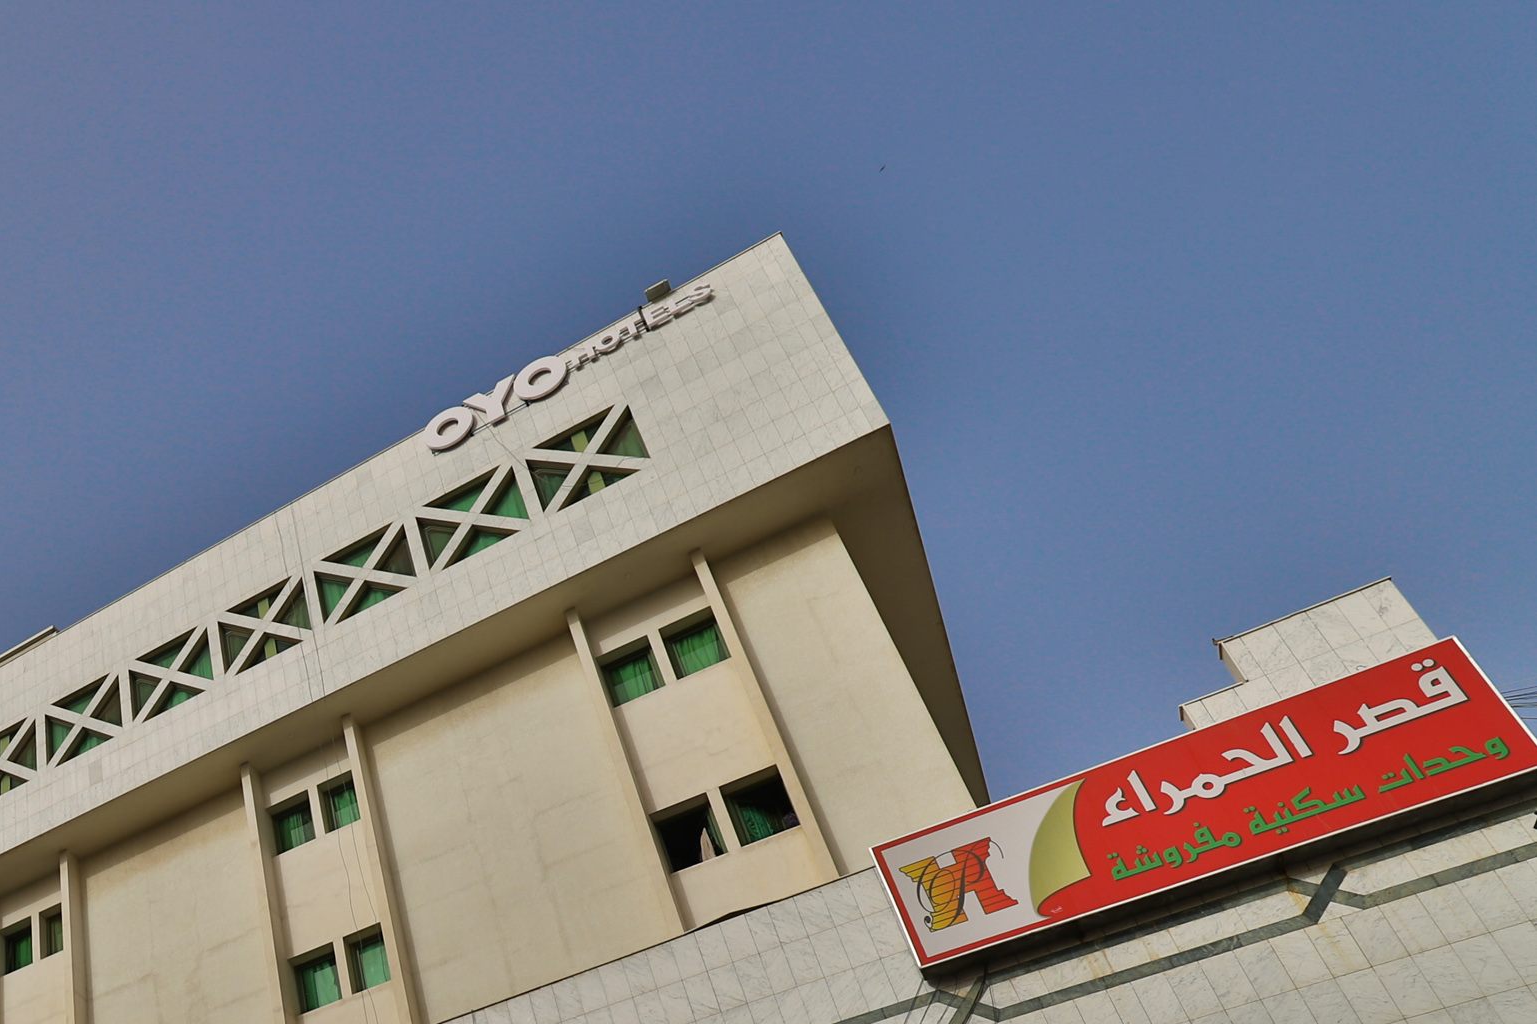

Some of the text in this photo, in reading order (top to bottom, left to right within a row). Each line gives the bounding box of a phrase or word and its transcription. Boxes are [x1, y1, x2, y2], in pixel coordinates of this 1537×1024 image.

[424, 283, 715, 450] OYO HOTELS
[1101, 657, 1469, 828] قصر الحمراء
[1109, 735, 1511, 882] وحدات سكنية مفروشة
